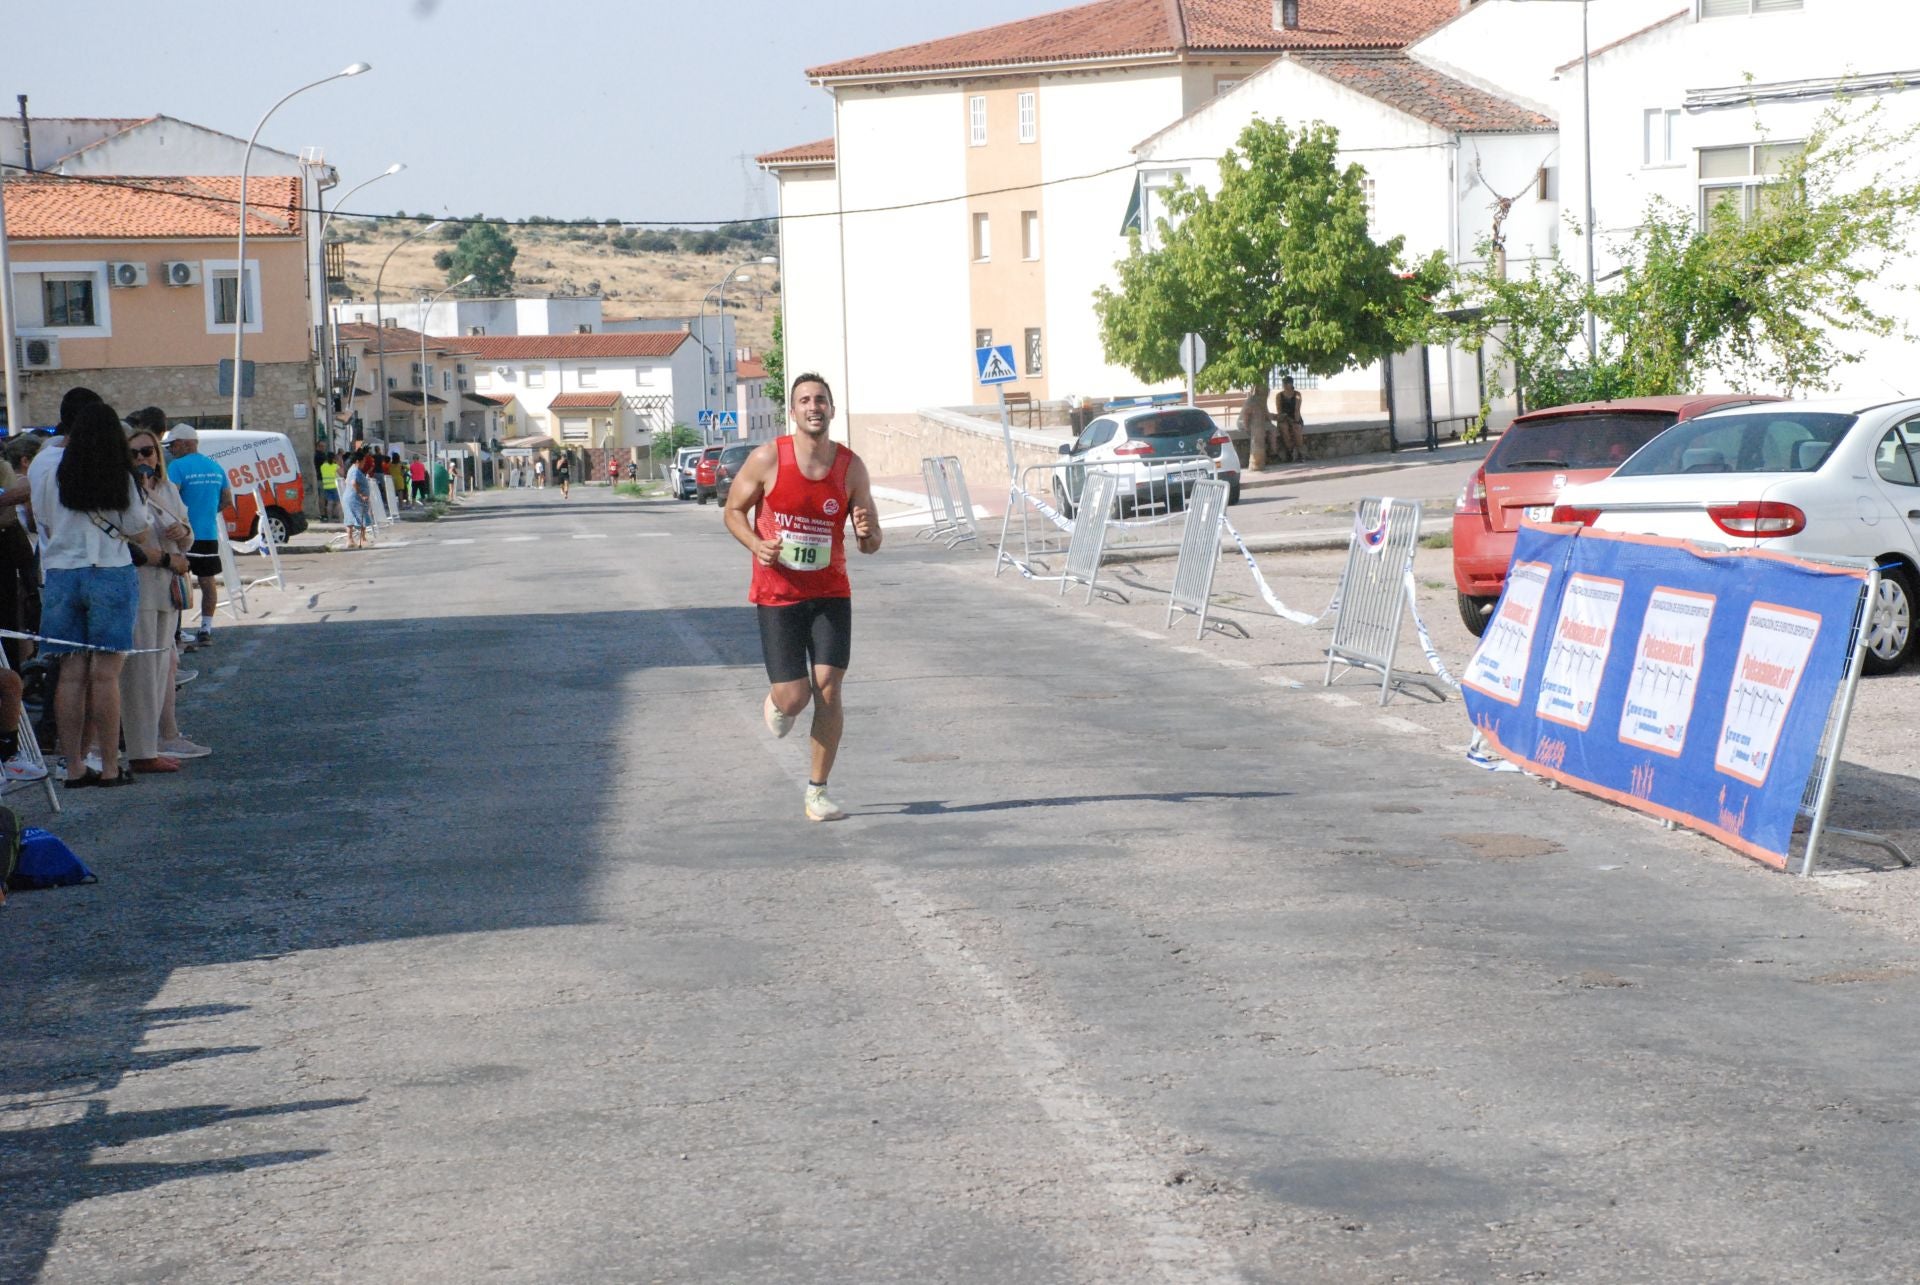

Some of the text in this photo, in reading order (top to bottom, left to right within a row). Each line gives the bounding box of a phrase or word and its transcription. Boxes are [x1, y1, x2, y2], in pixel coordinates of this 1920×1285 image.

[243, 441, 253, 450] de
[774, 511, 794, 527] XIV
[794, 546, 817, 564] 119
